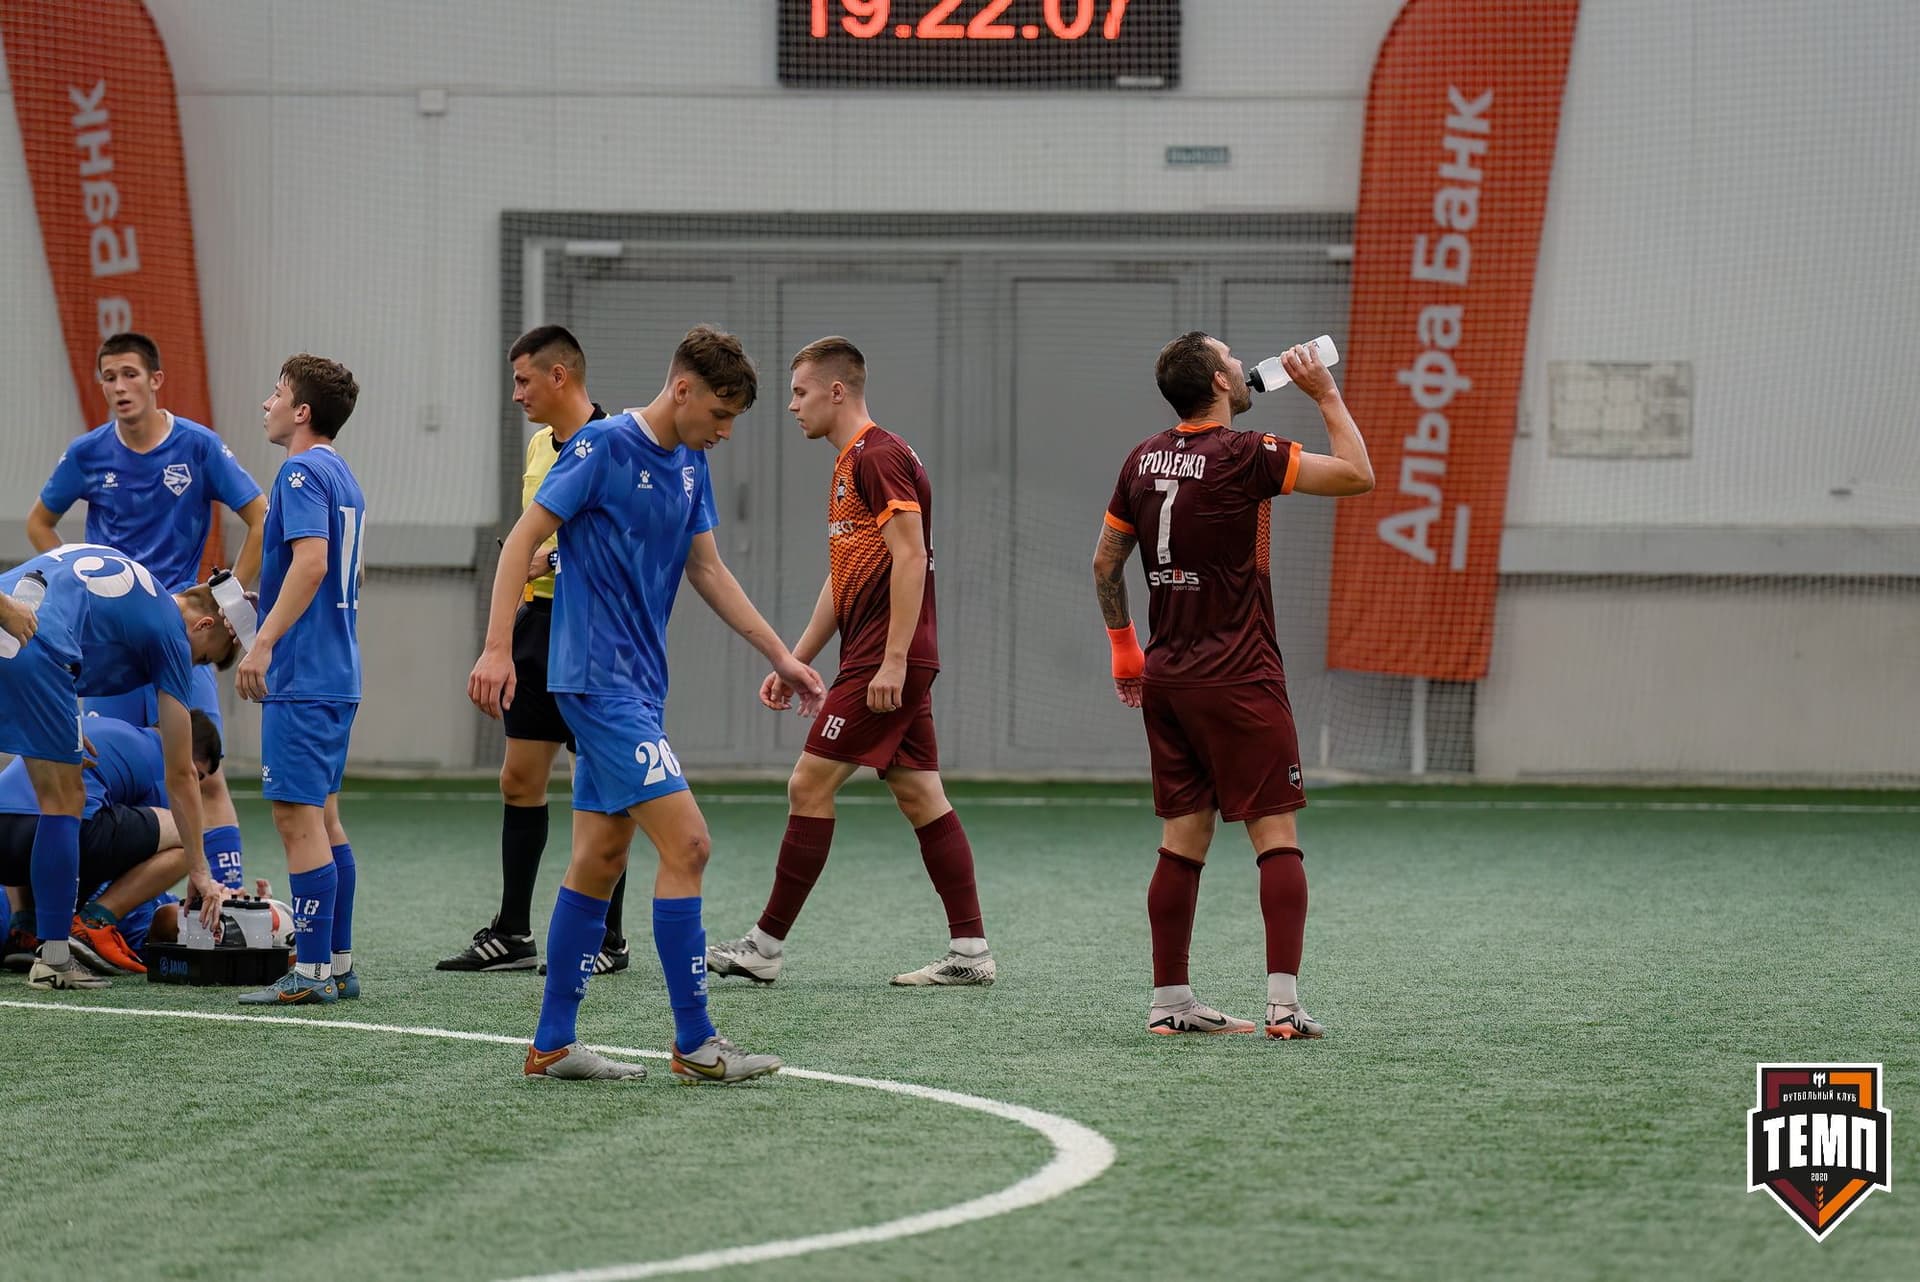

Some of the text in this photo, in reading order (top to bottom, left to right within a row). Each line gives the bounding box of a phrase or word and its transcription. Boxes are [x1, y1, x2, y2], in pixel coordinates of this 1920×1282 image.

[1377, 84, 1494, 565] Альфа Банк
[1155, 479, 1179, 565] 7
[821, 714, 846, 740] 15
[217, 851, 241, 868] 20
